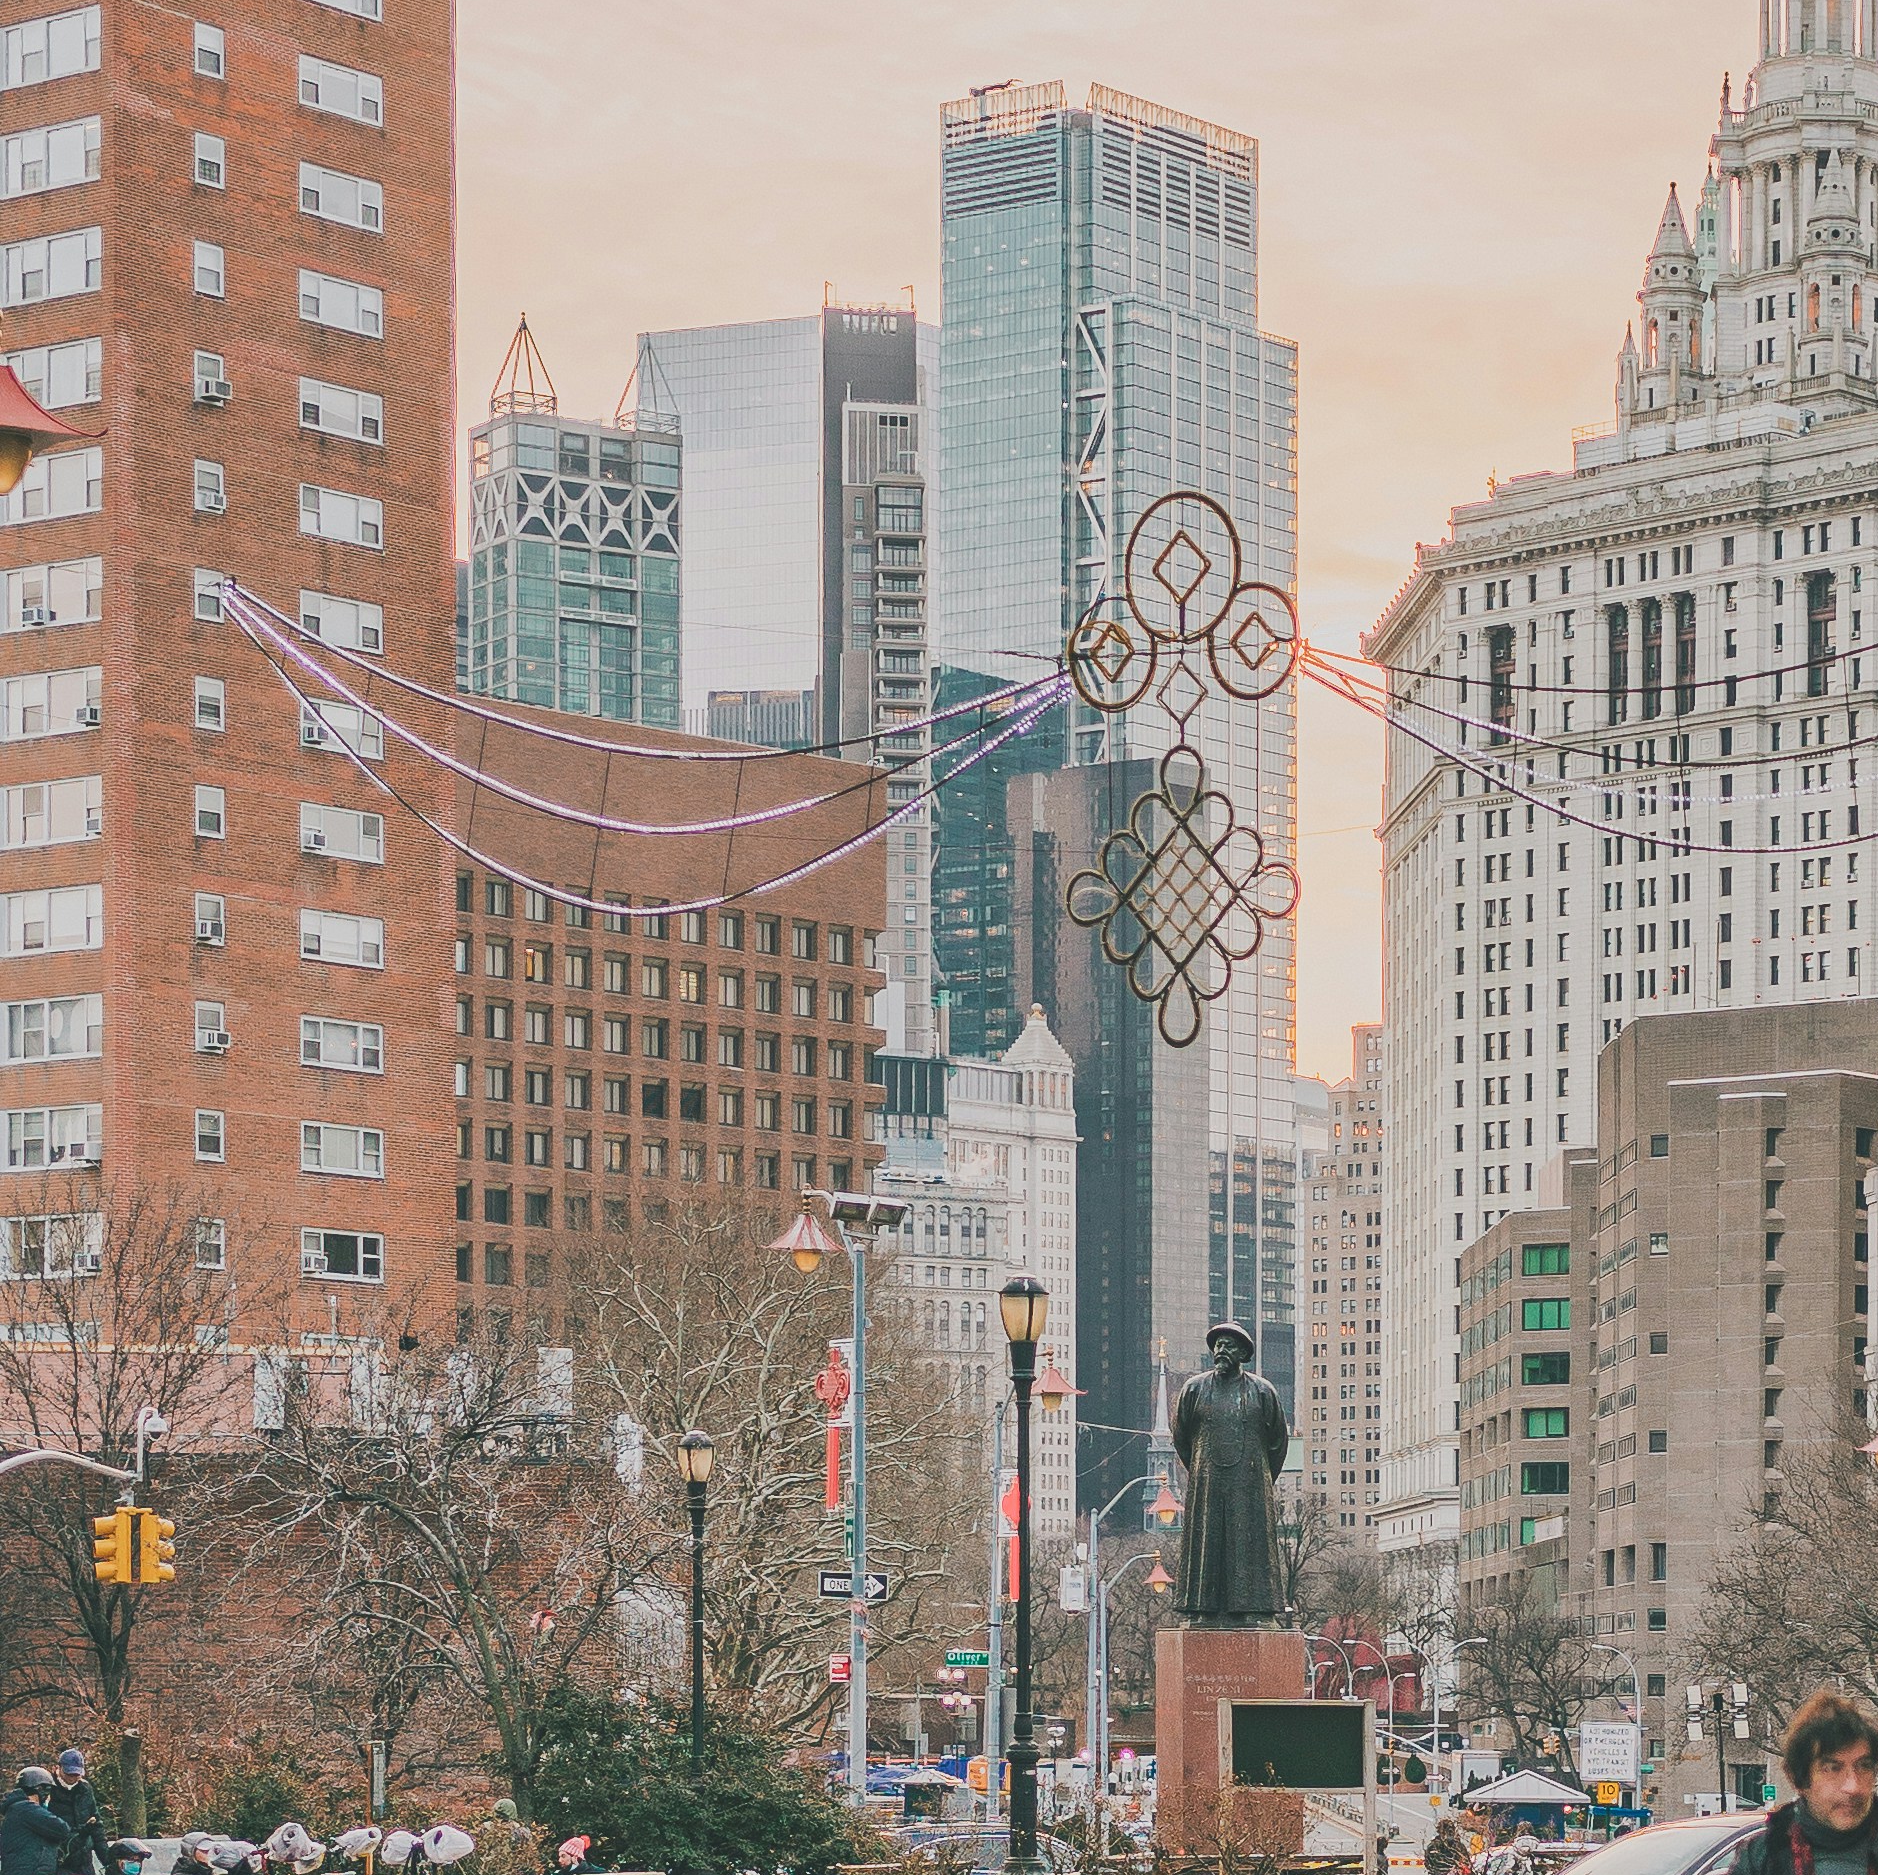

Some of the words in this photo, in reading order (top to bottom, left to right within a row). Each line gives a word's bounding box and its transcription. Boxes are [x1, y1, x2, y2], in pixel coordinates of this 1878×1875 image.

[830, 1579, 848, 1590] ONE
[947, 1653, 981, 1662] Oliver
[1602, 1785, 1616, 1795] 10
